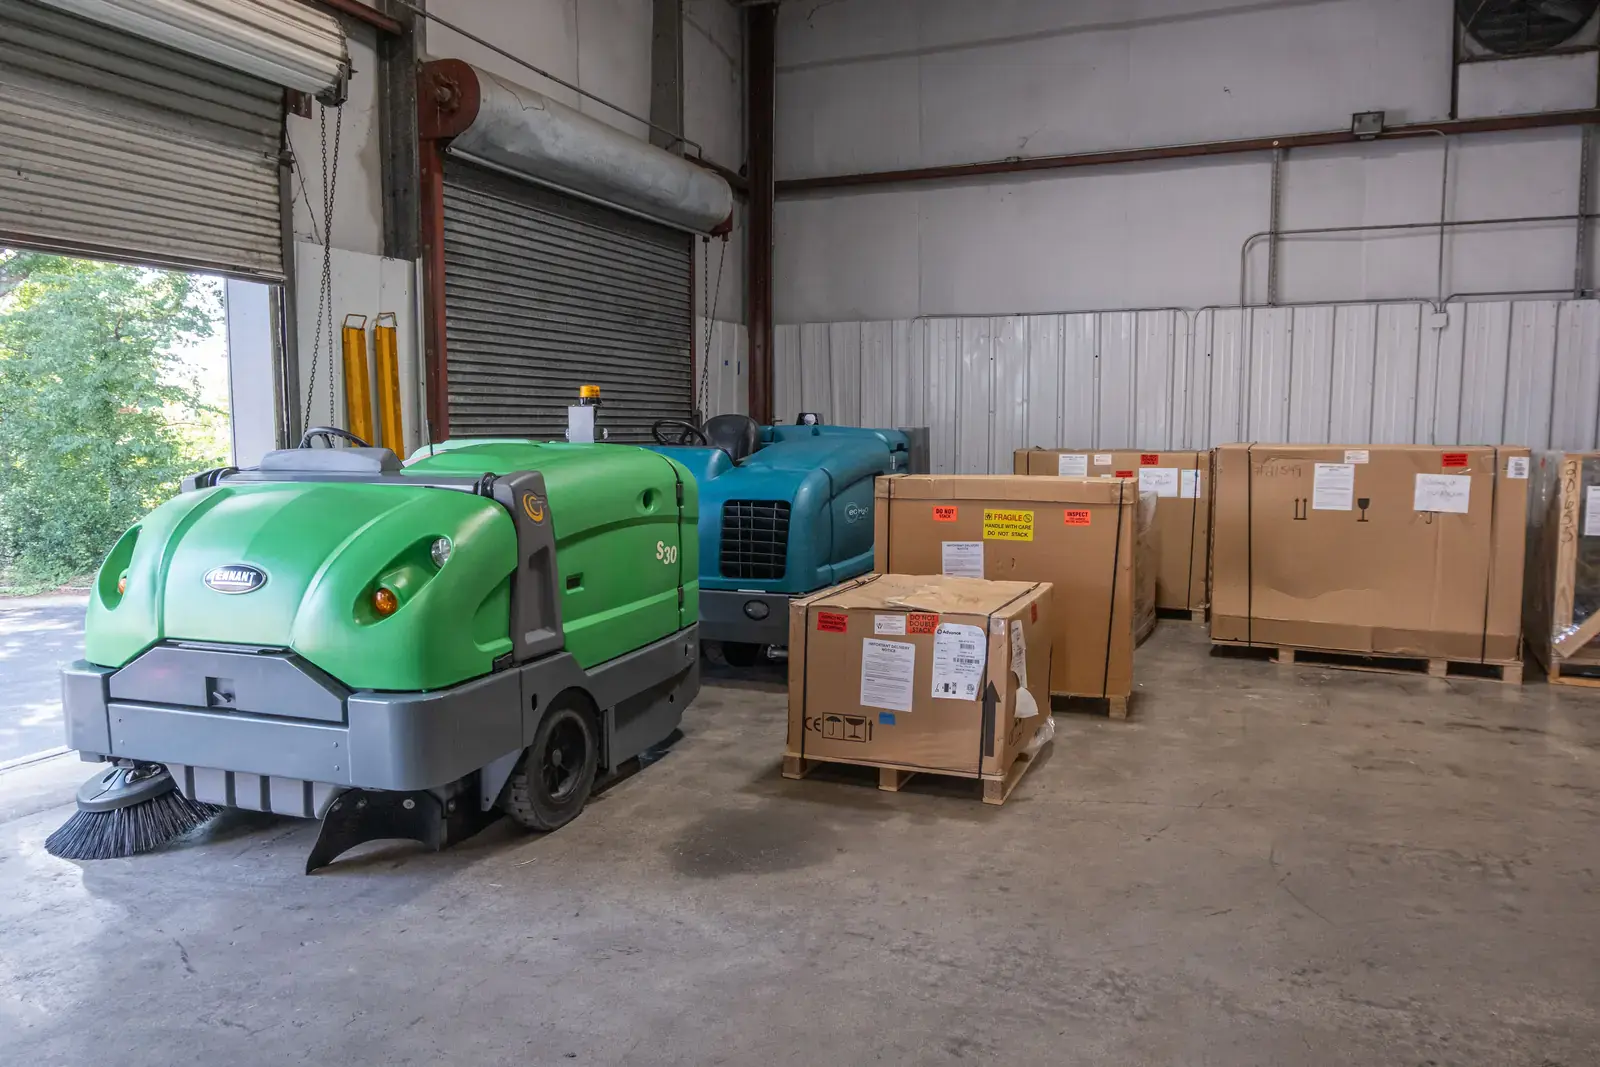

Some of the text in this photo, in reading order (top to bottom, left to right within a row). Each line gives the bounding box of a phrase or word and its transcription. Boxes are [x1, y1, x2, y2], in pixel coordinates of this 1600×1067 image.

[994, 513, 1023, 521] FRAGILE
[656, 540, 677, 565] S30
[211, 570, 257, 586] TENNANT
